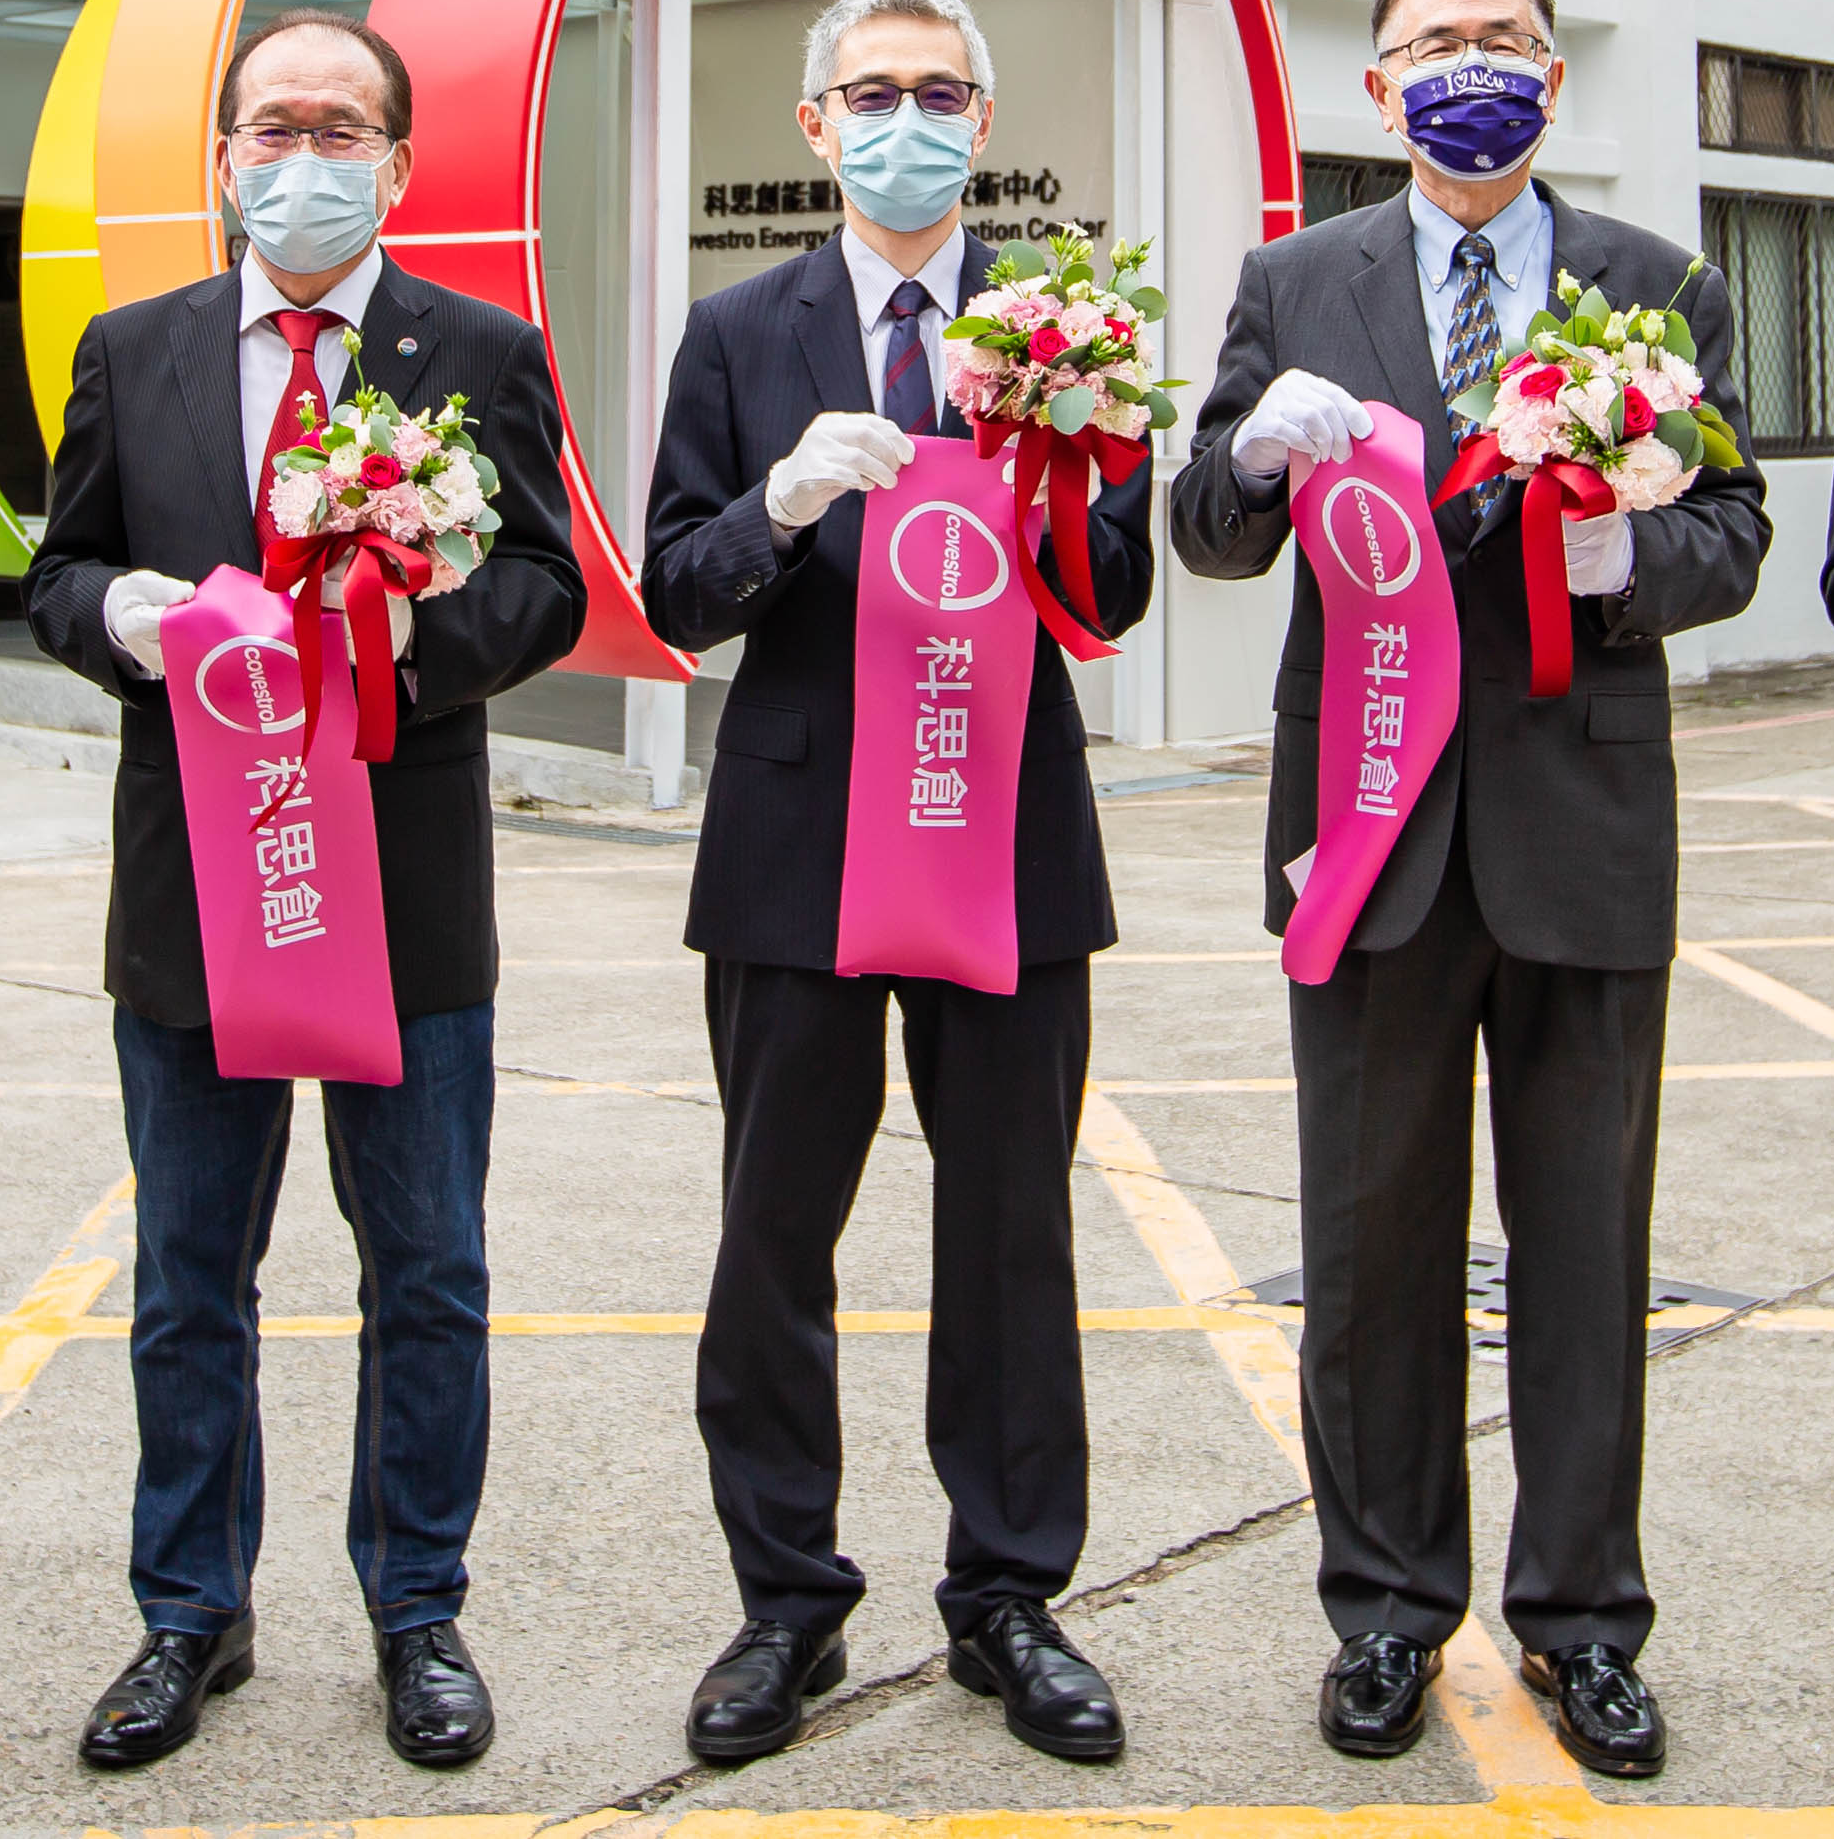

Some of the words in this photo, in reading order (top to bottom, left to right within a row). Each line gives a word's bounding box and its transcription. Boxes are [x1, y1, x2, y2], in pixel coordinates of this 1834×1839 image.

[759, 225, 830, 252] Energy
[938, 514, 962, 598] covestro
[1353, 486, 1385, 582] covestro
[243, 646, 276, 723] covestro
[909, 635, 974, 828] 科思創
[1355, 621, 1409, 818] 科思創
[244, 755, 328, 949] 科思創
